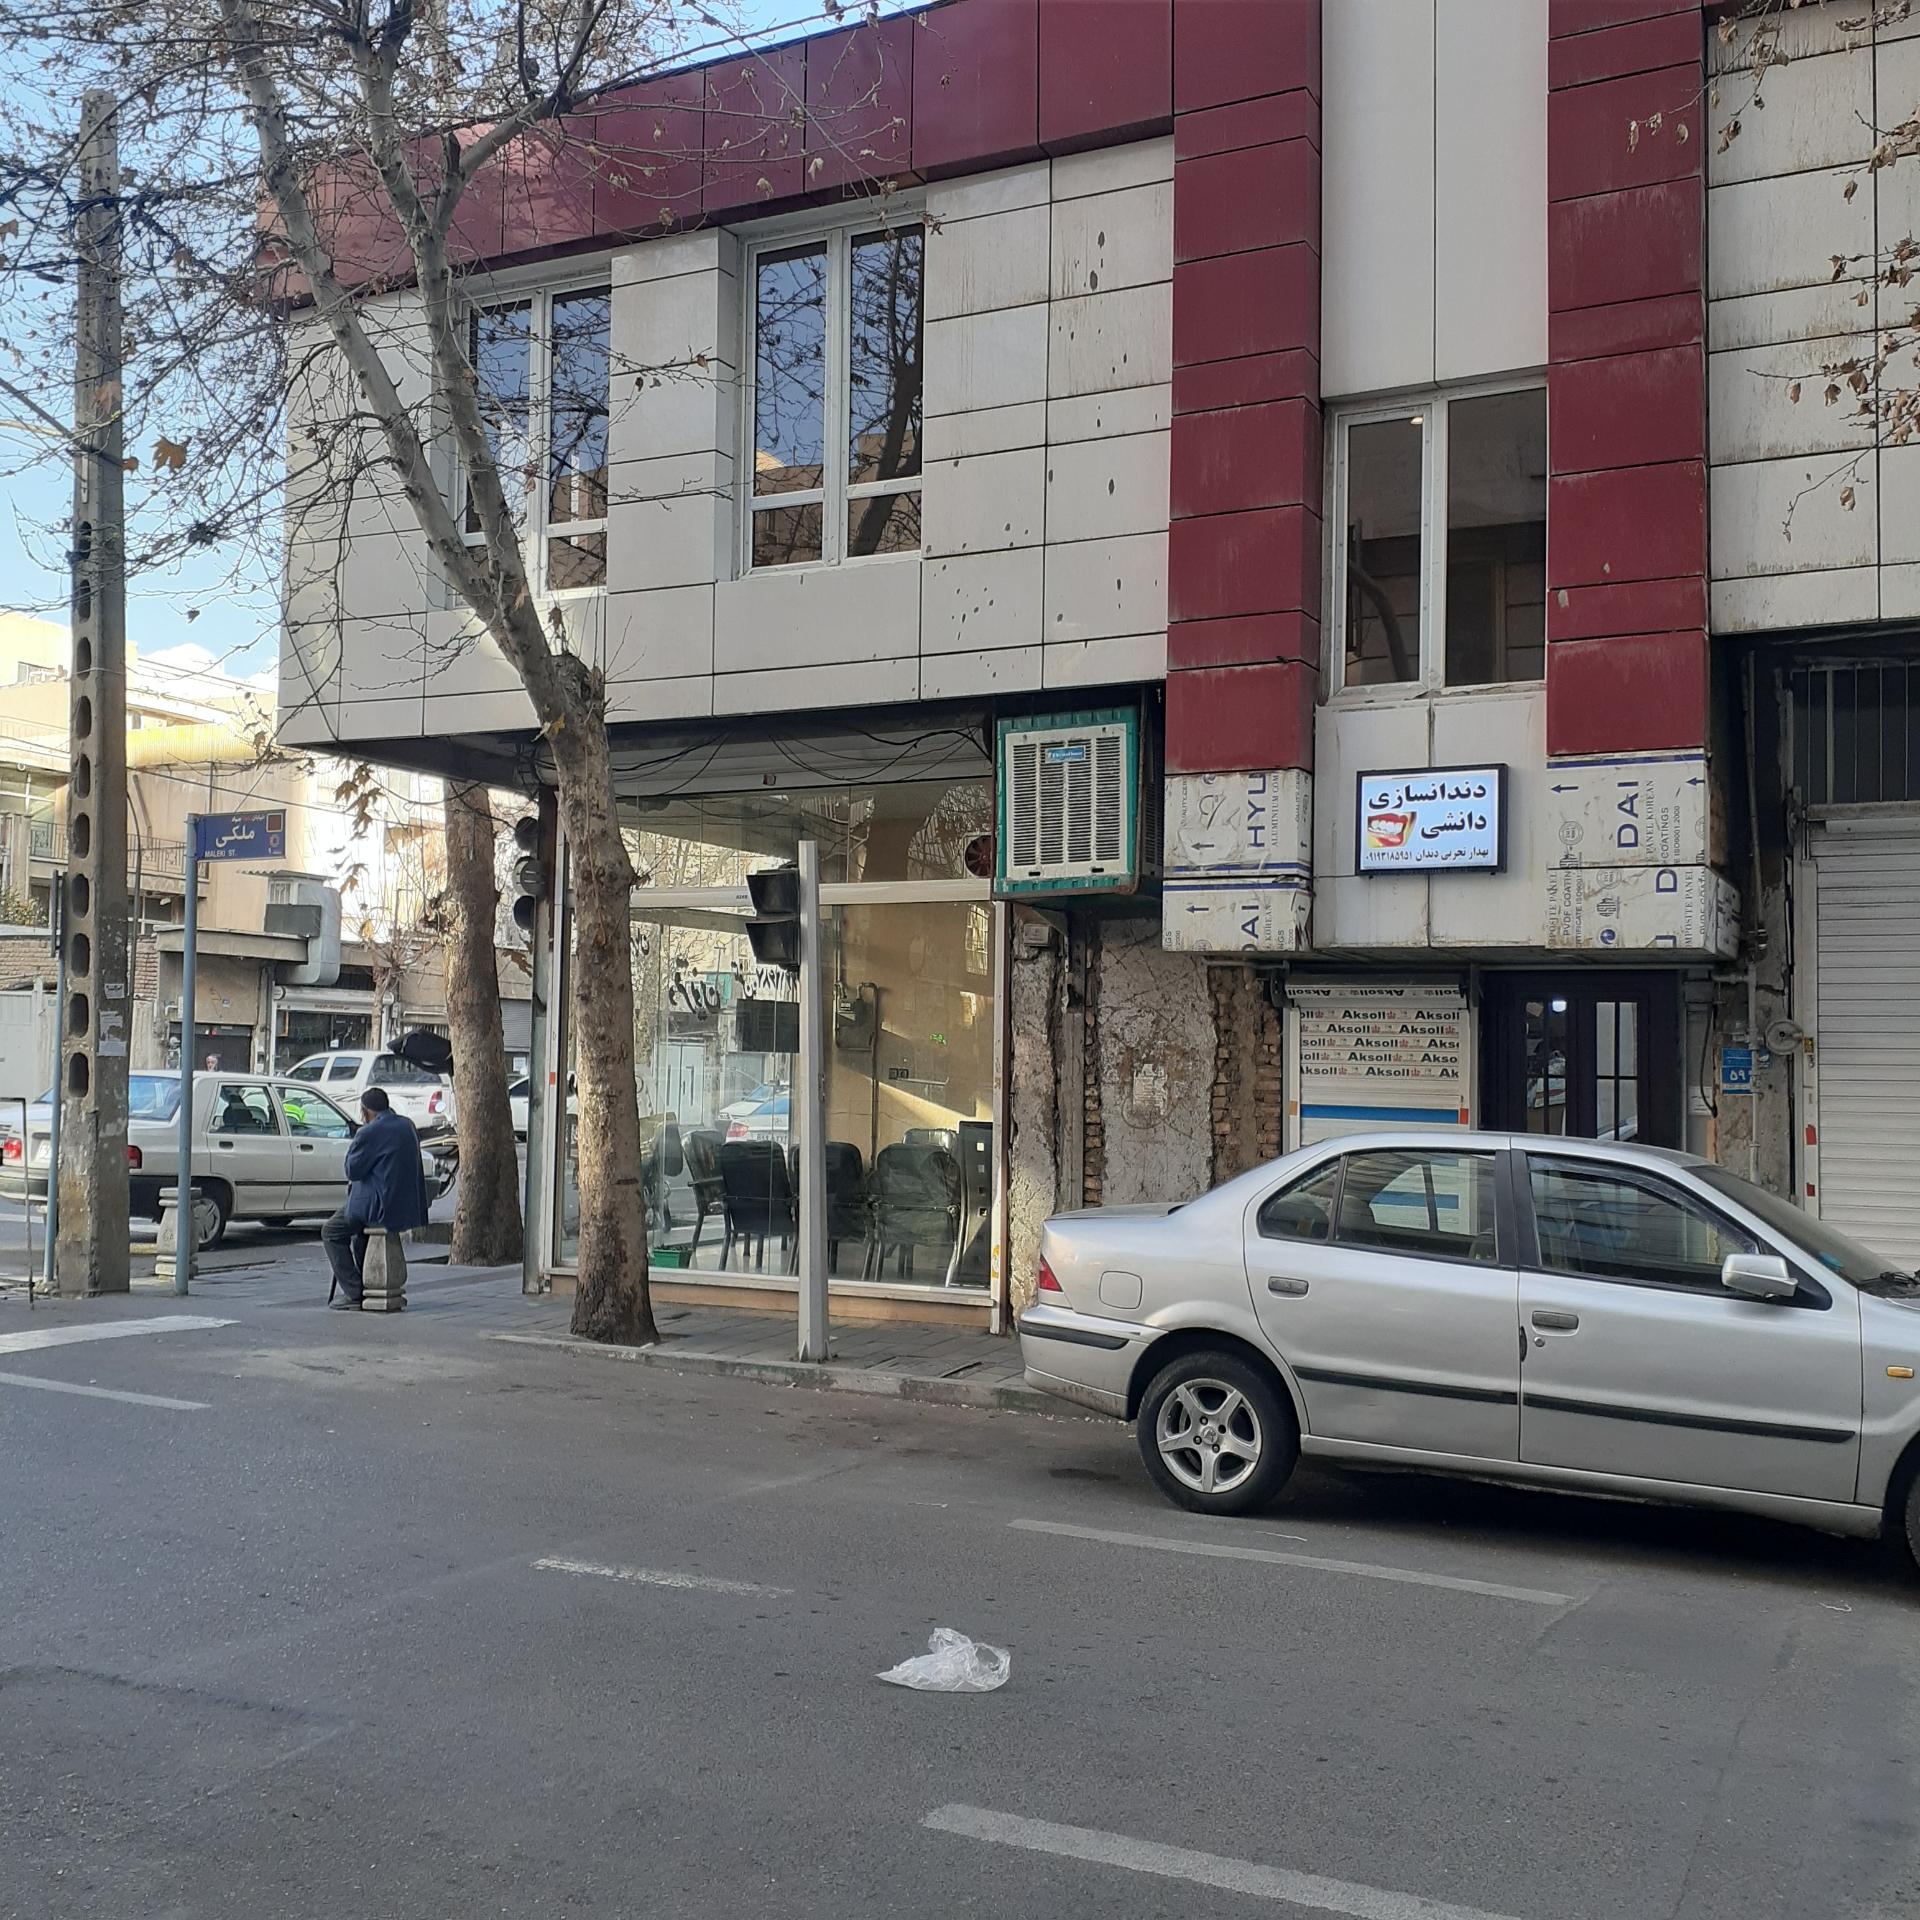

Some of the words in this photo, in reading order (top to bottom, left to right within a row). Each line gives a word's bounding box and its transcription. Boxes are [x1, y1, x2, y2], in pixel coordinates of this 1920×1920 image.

[1368, 781, 1487, 809] دندانسازی
[1645, 780, 1654, 820] KOREAN
[1421, 811, 1487, 839] دانشی
[1617, 781, 1639, 848] DAI
[215, 825, 255, 848] ملکی
[1646, 823, 1654, 854] PANEL
[1660, 807, 1669, 859] COATINGS
[1563, 911, 1572, 936] PVDF
[1342, 1010, 1385, 1020] Aksoll
[1327, 1024, 1370, 1033] Aksoll
[1399, 1024, 1444, 1034] Aksoll
[1354, 1038, 1398, 1048] Aksoll
[1348, 1052, 1392, 1062] Aksoll
[1366, 1066, 1410, 1077] Aksoll
